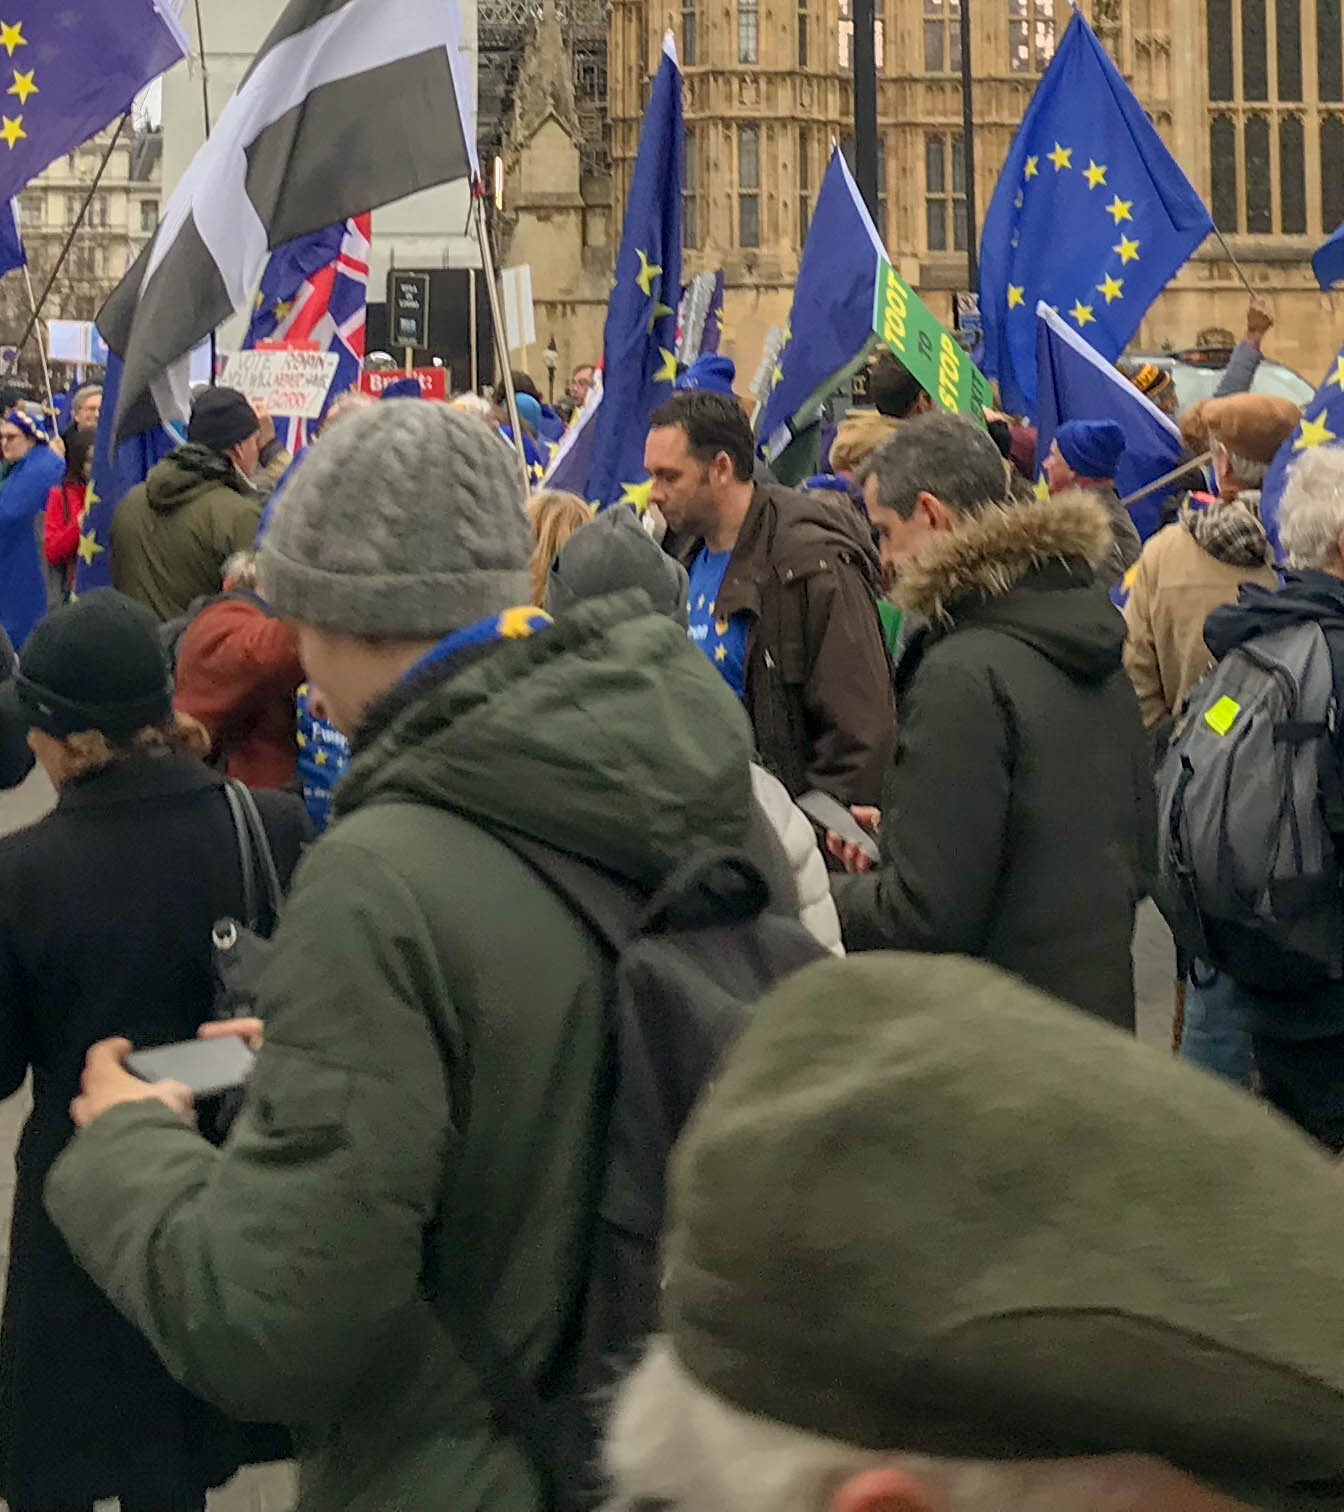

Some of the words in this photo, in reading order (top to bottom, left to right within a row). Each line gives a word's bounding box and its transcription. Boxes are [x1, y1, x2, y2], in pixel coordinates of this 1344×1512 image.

[884, 267, 908, 353] TOOT
[918, 329, 933, 362] TO
[939, 332, 960, 415] STOP
